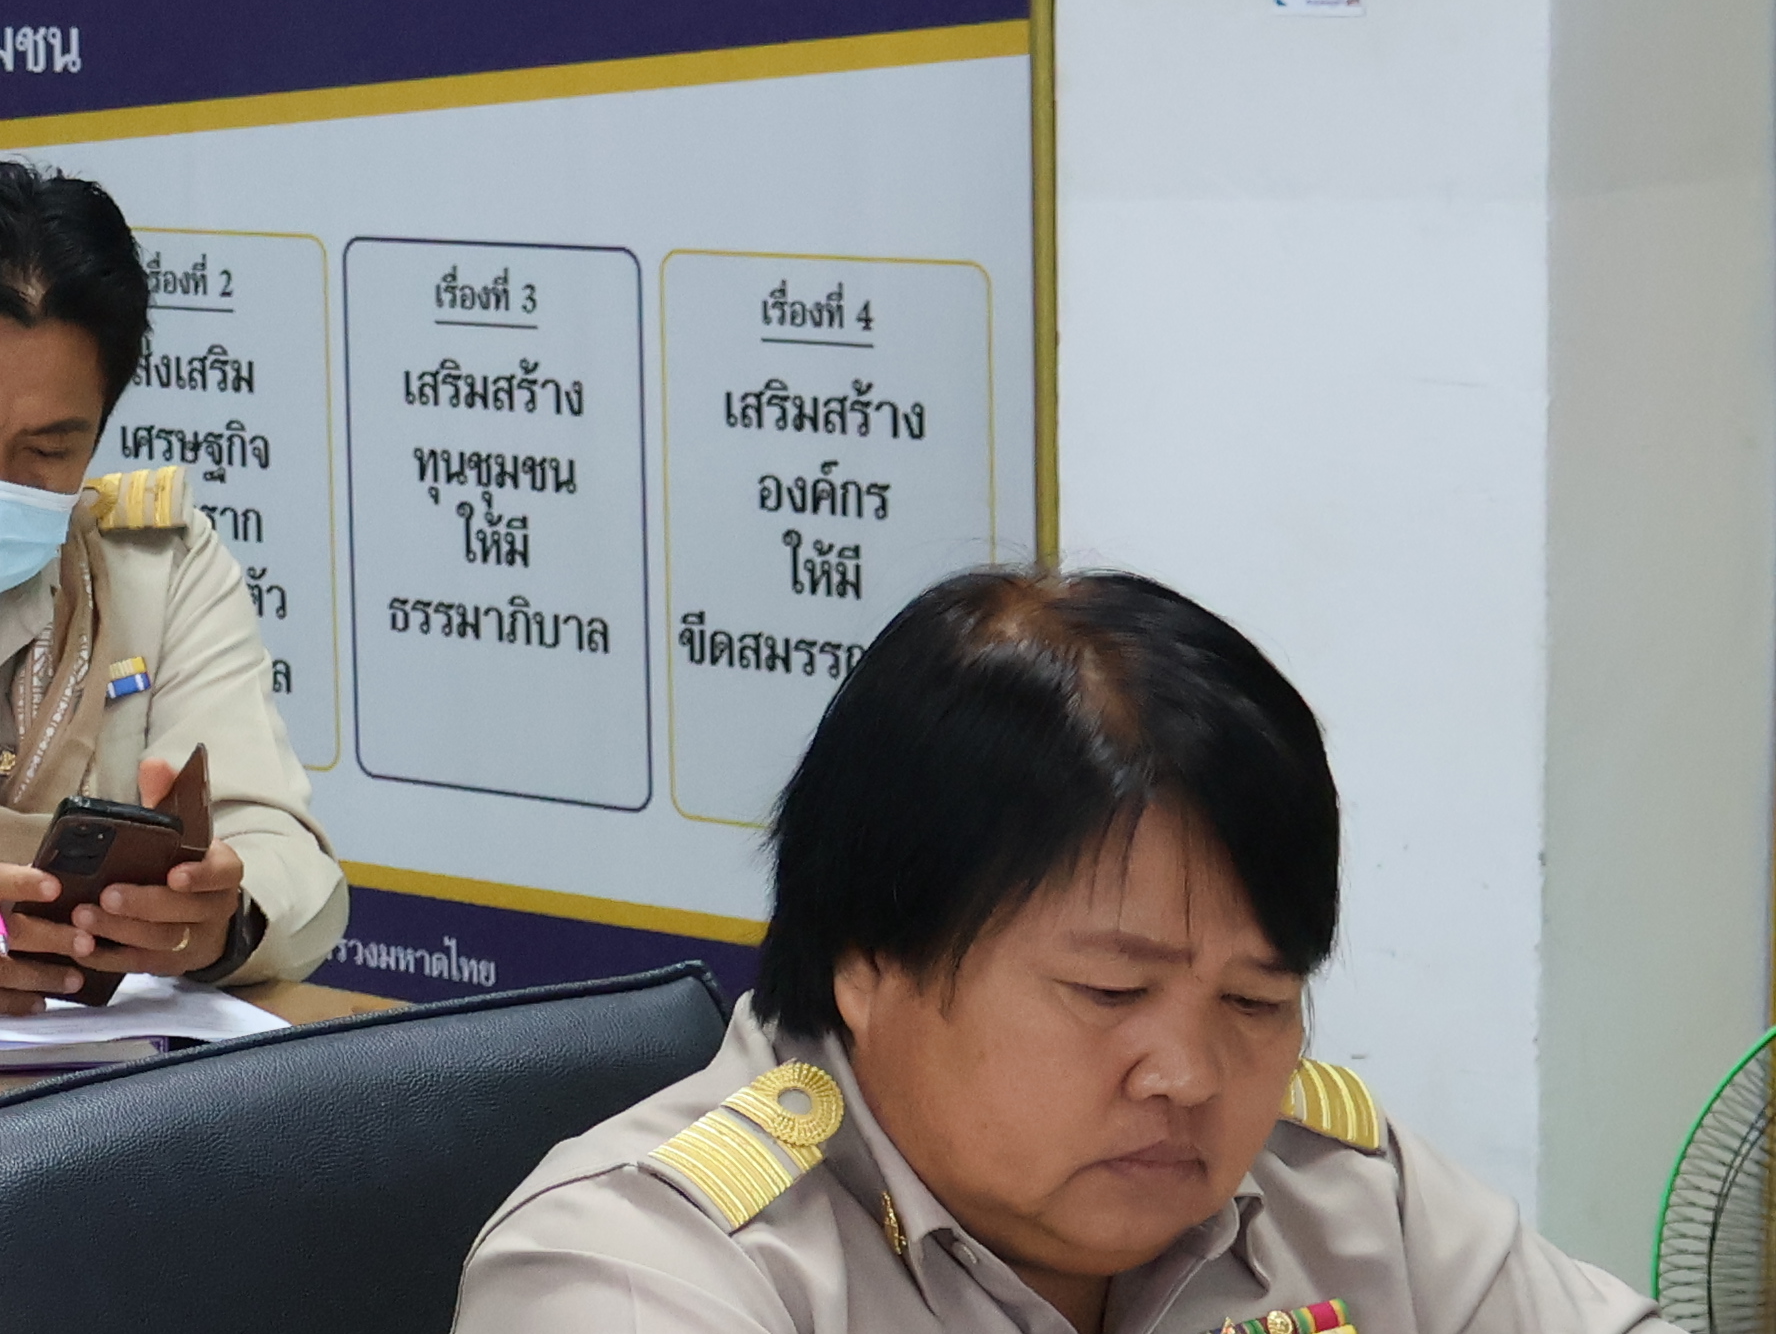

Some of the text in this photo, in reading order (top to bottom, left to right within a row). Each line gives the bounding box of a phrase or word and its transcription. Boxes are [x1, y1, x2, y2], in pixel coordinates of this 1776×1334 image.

[146, 251, 234, 297] รื่องที่ 2
[434, 266, 538, 314] เรื่องที่ 3
[761, 279, 874, 331] เรื่องที่ 4
[404, 358, 584, 417] เสริมสร้าง
[725, 378, 926, 440] เสริมสร้าง
[119, 420, 270, 484] เศรษฐกิจ
[414, 446, 577, 510] ทุนชุมชน
[758, 460, 891, 521] องค์กร
[457, 501, 530, 567] ให้มี
[782, 529, 863, 600] ให้มี
[388, 595, 610, 655] ธรรมาภิบาล
[326, 935, 497, 987] รวงมหาดไทย
